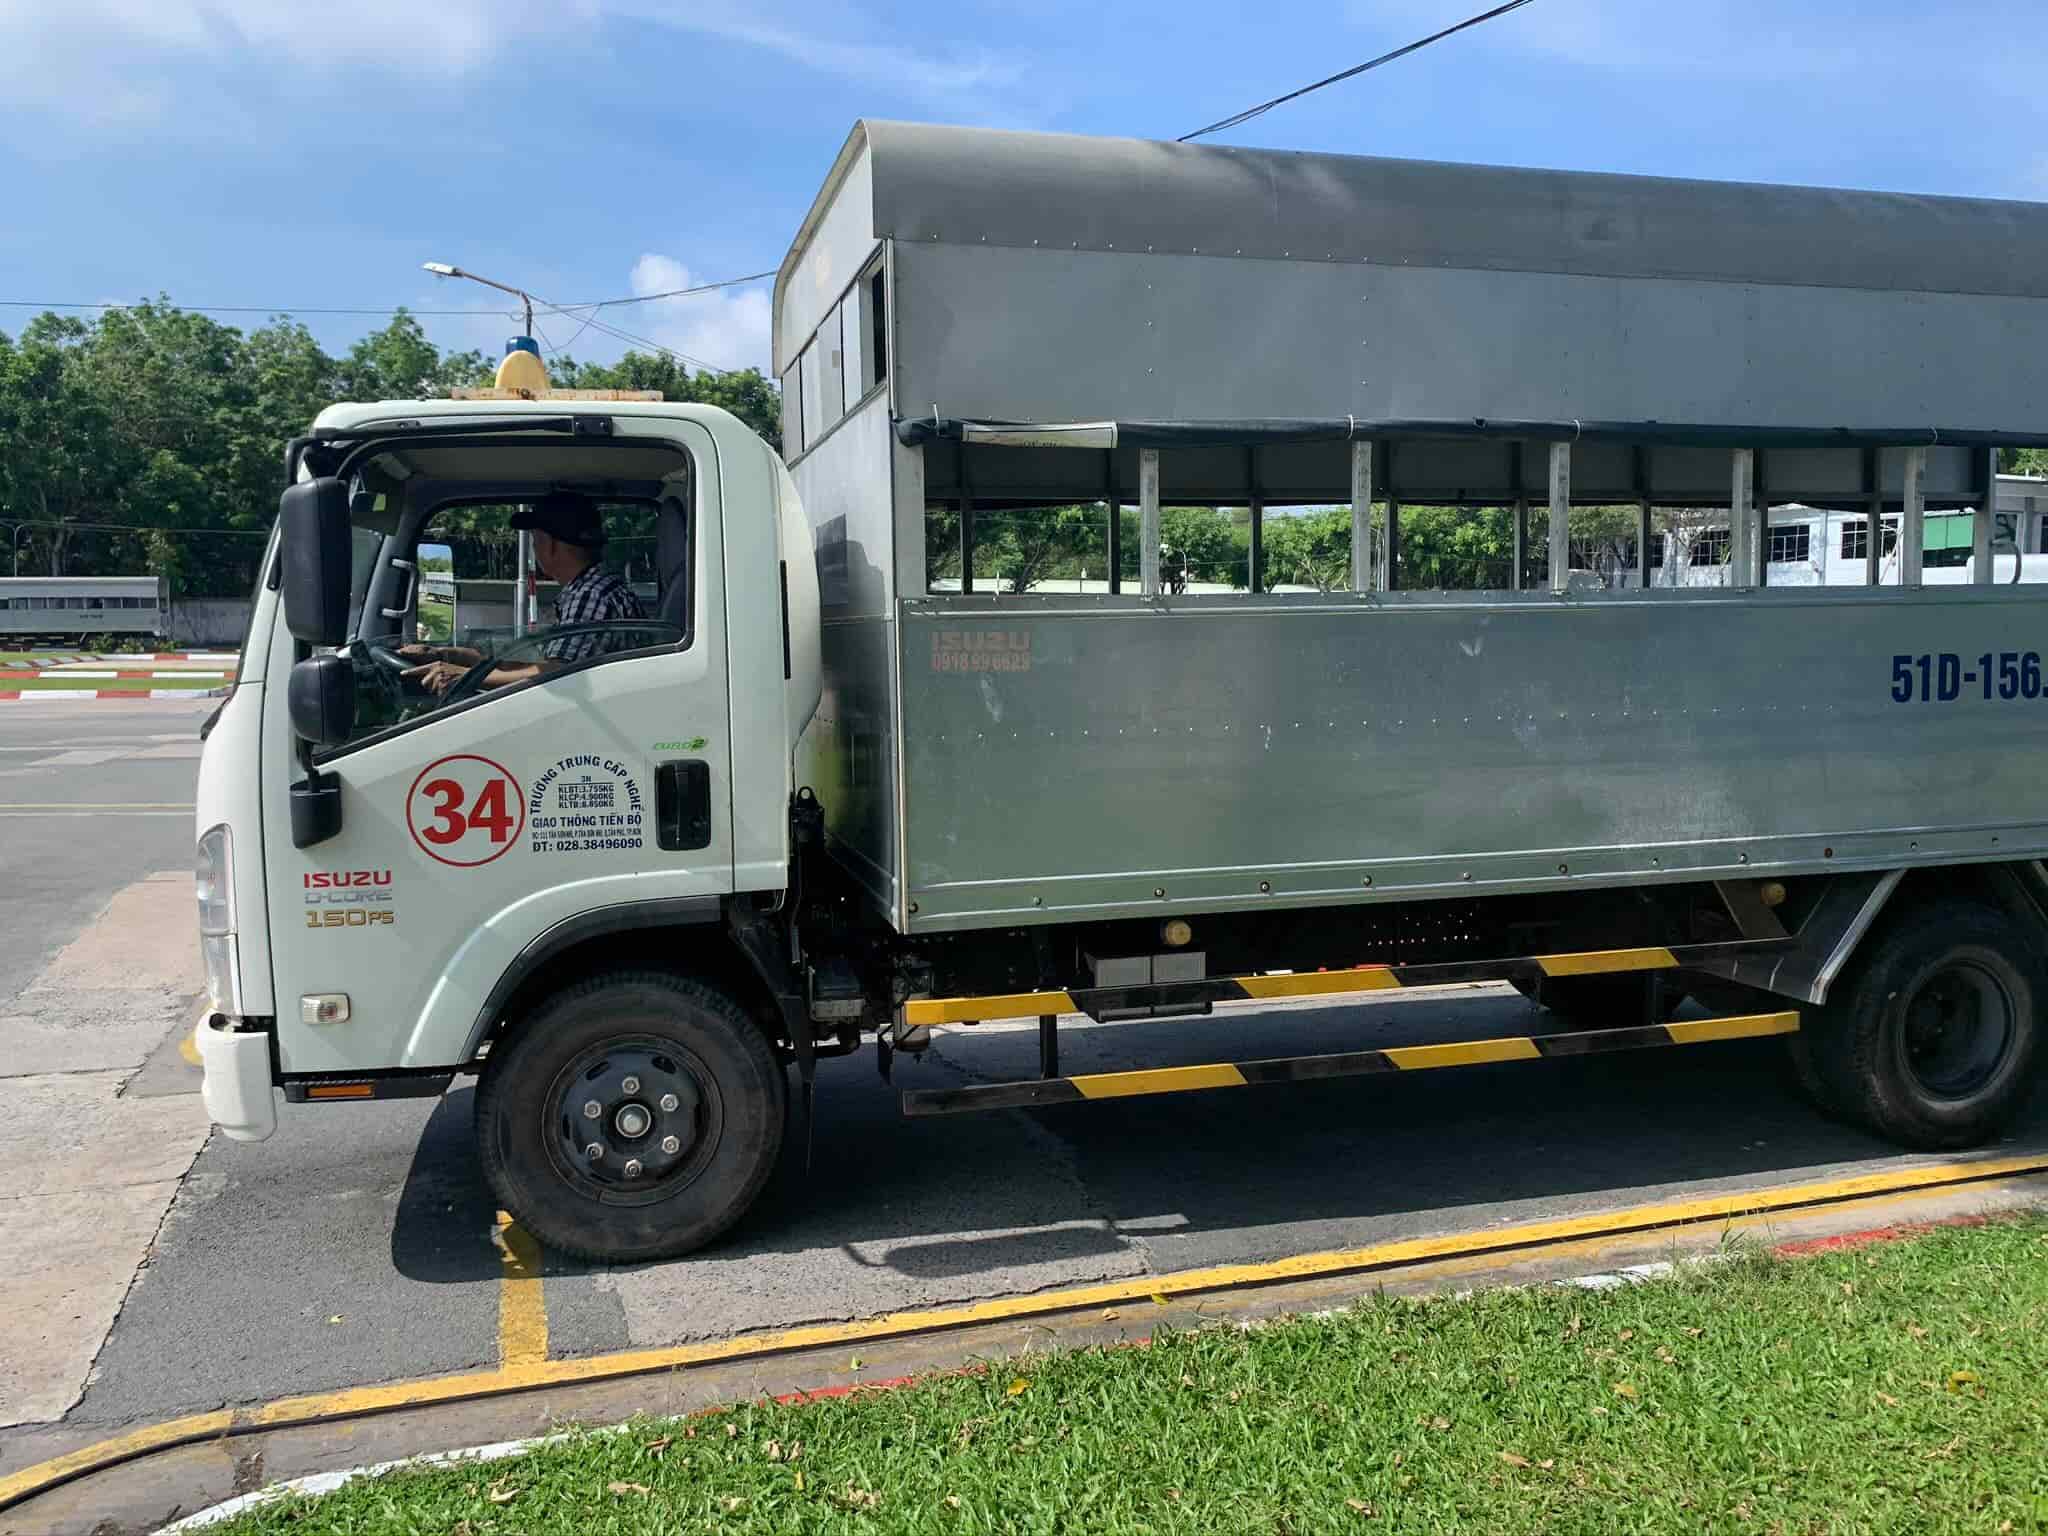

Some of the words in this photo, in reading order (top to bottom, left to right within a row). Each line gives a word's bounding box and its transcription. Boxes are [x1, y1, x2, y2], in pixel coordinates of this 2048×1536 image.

[556, 755, 601, 772] TRUNG
[421, 779, 514, 845] 34
[532, 817, 557, 828] GIAO
[560, 813, 597, 827] THÔNG
[556, 839, 642, 851] 028.38496090
[303, 870, 392, 889] ISUZU
